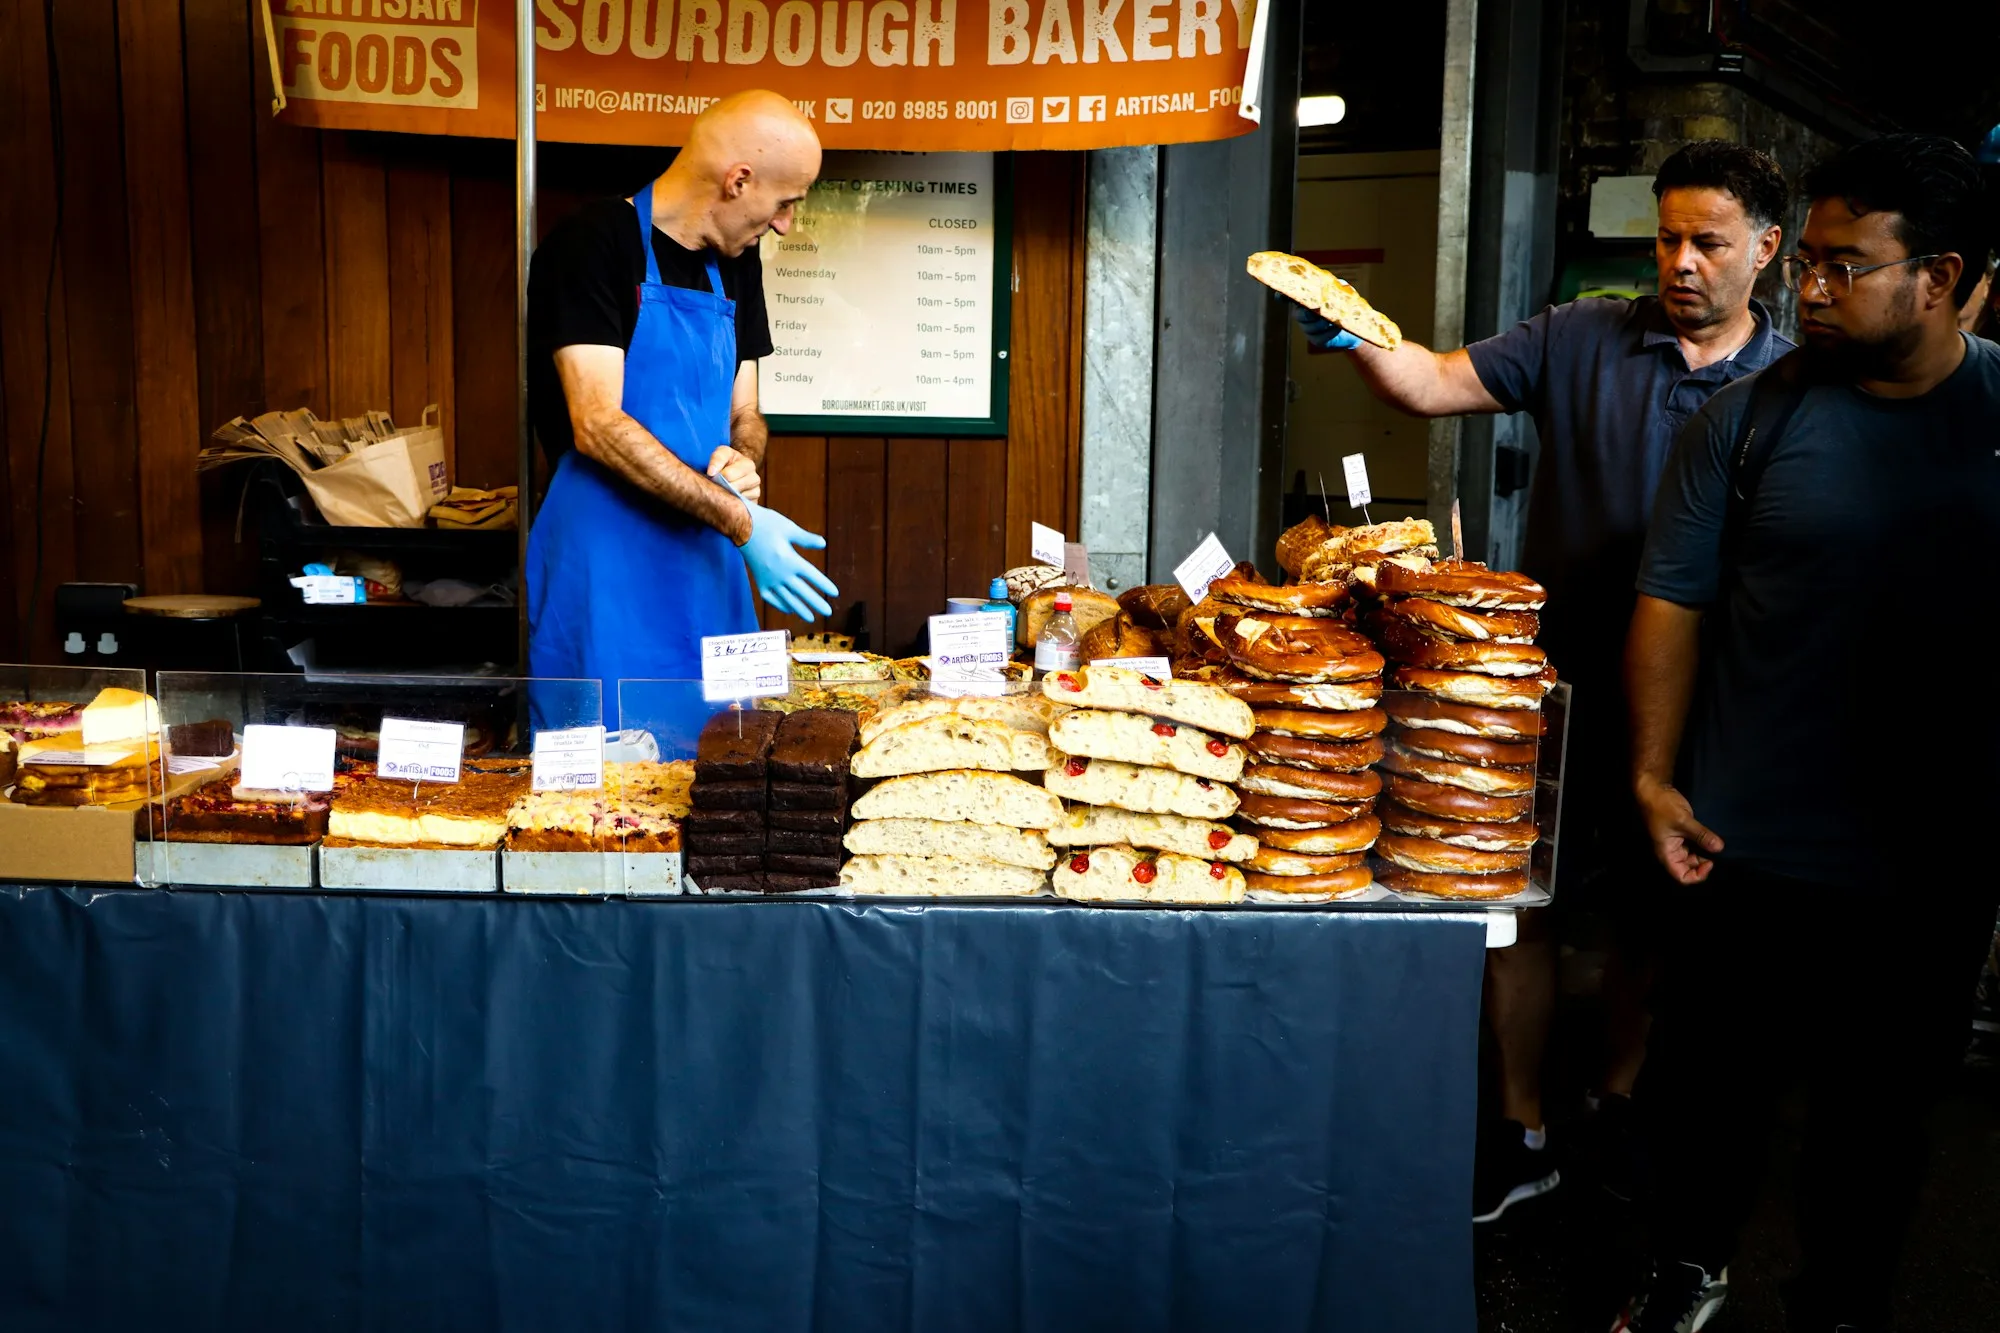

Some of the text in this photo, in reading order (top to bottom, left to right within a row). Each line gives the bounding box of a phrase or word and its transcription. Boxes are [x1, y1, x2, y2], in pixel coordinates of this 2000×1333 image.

[536, 0, 955, 67] SOURDOUGH
[283, 27, 463, 97] FOODS
[555, 87, 721, 115] INFO@ARTISANF
[862, 101, 998, 119] 020 8985 8001
[928, 182, 978, 195] TIMES
[929, 218, 977, 229] CLOSED
[777, 241, 819, 253] Tuesday
[917, 245, 943, 255] 10am
[953, 246, 976, 258] 5pm
[776, 268, 836, 280] Wednesday
[917, 271, 943, 281] 10am
[953, 272, 976, 284] 5pm
[776, 294, 824, 306] Thursday
[917, 297, 943, 307] 10am
[953, 298, 976, 310] 5pm
[775, 320, 807, 332] Friday
[917, 323, 942, 333] 10am
[953, 324, 975, 336] 5pm
[775, 346, 823, 358] Saturday
[921, 349, 942, 359] 9am
[953, 350, 975, 362] 5pm
[775, 372, 814, 384] Sunday
[916, 375, 942, 385] 10am
[953, 376, 975, 388] 4pm
[822, 400, 926, 412] BOROUGHMARKET.ORG.UK/VISIT
[951, 653, 1003, 664] ARTISAN FOODS
[756, 675, 782, 688] FOODS
[399, 765, 455, 777] ARTISAN FOODS
[576, 773, 597, 784] FOODS
